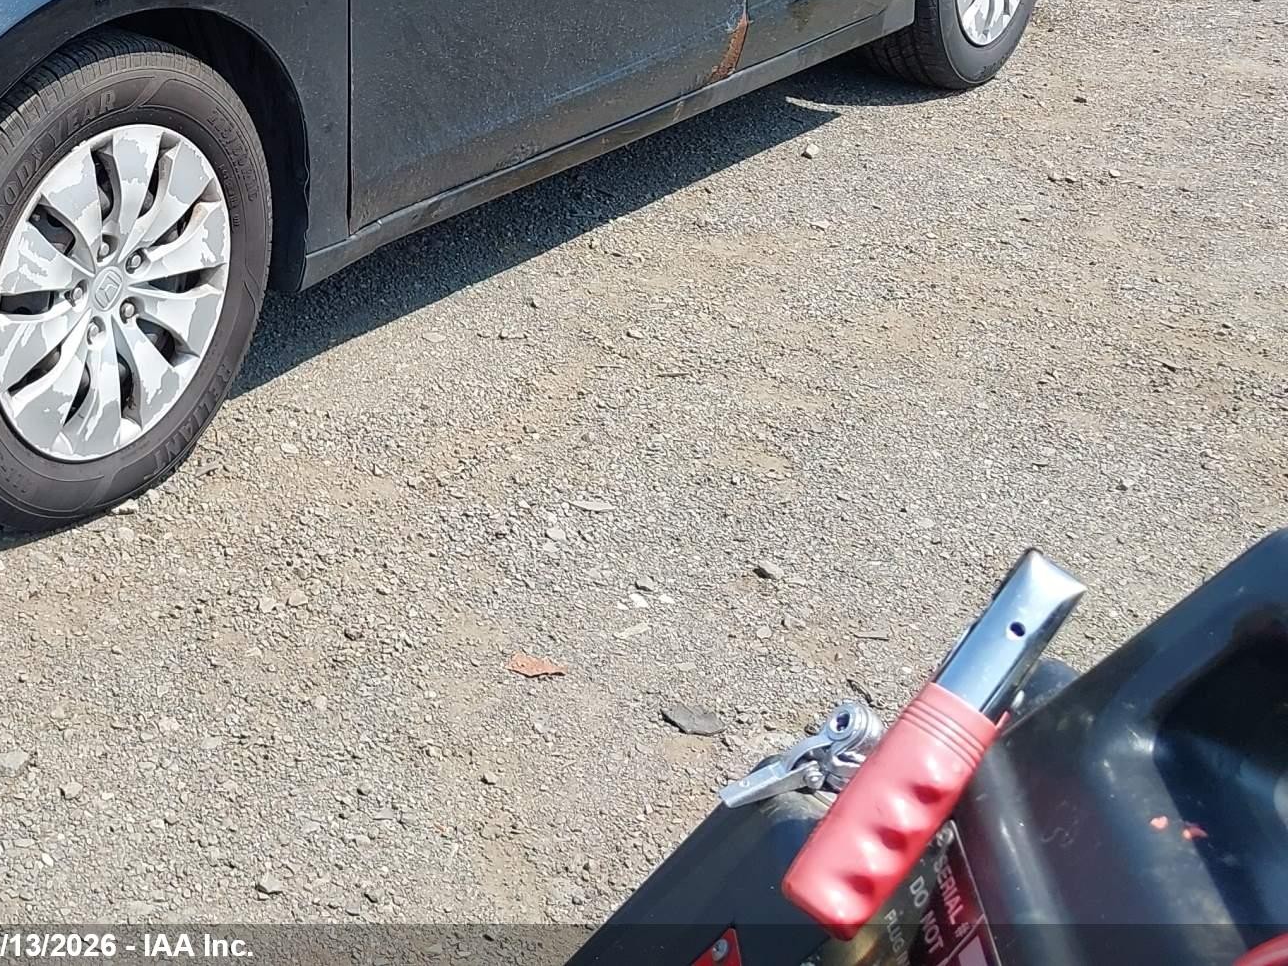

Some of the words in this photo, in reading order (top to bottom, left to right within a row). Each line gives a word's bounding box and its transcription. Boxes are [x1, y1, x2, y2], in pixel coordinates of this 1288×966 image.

[909, 876, 929, 908] DO
[920, 910, 944, 954] NOT
[933, 855, 964, 925] SERIAL
[884, 909, 905, 953] PLUG
